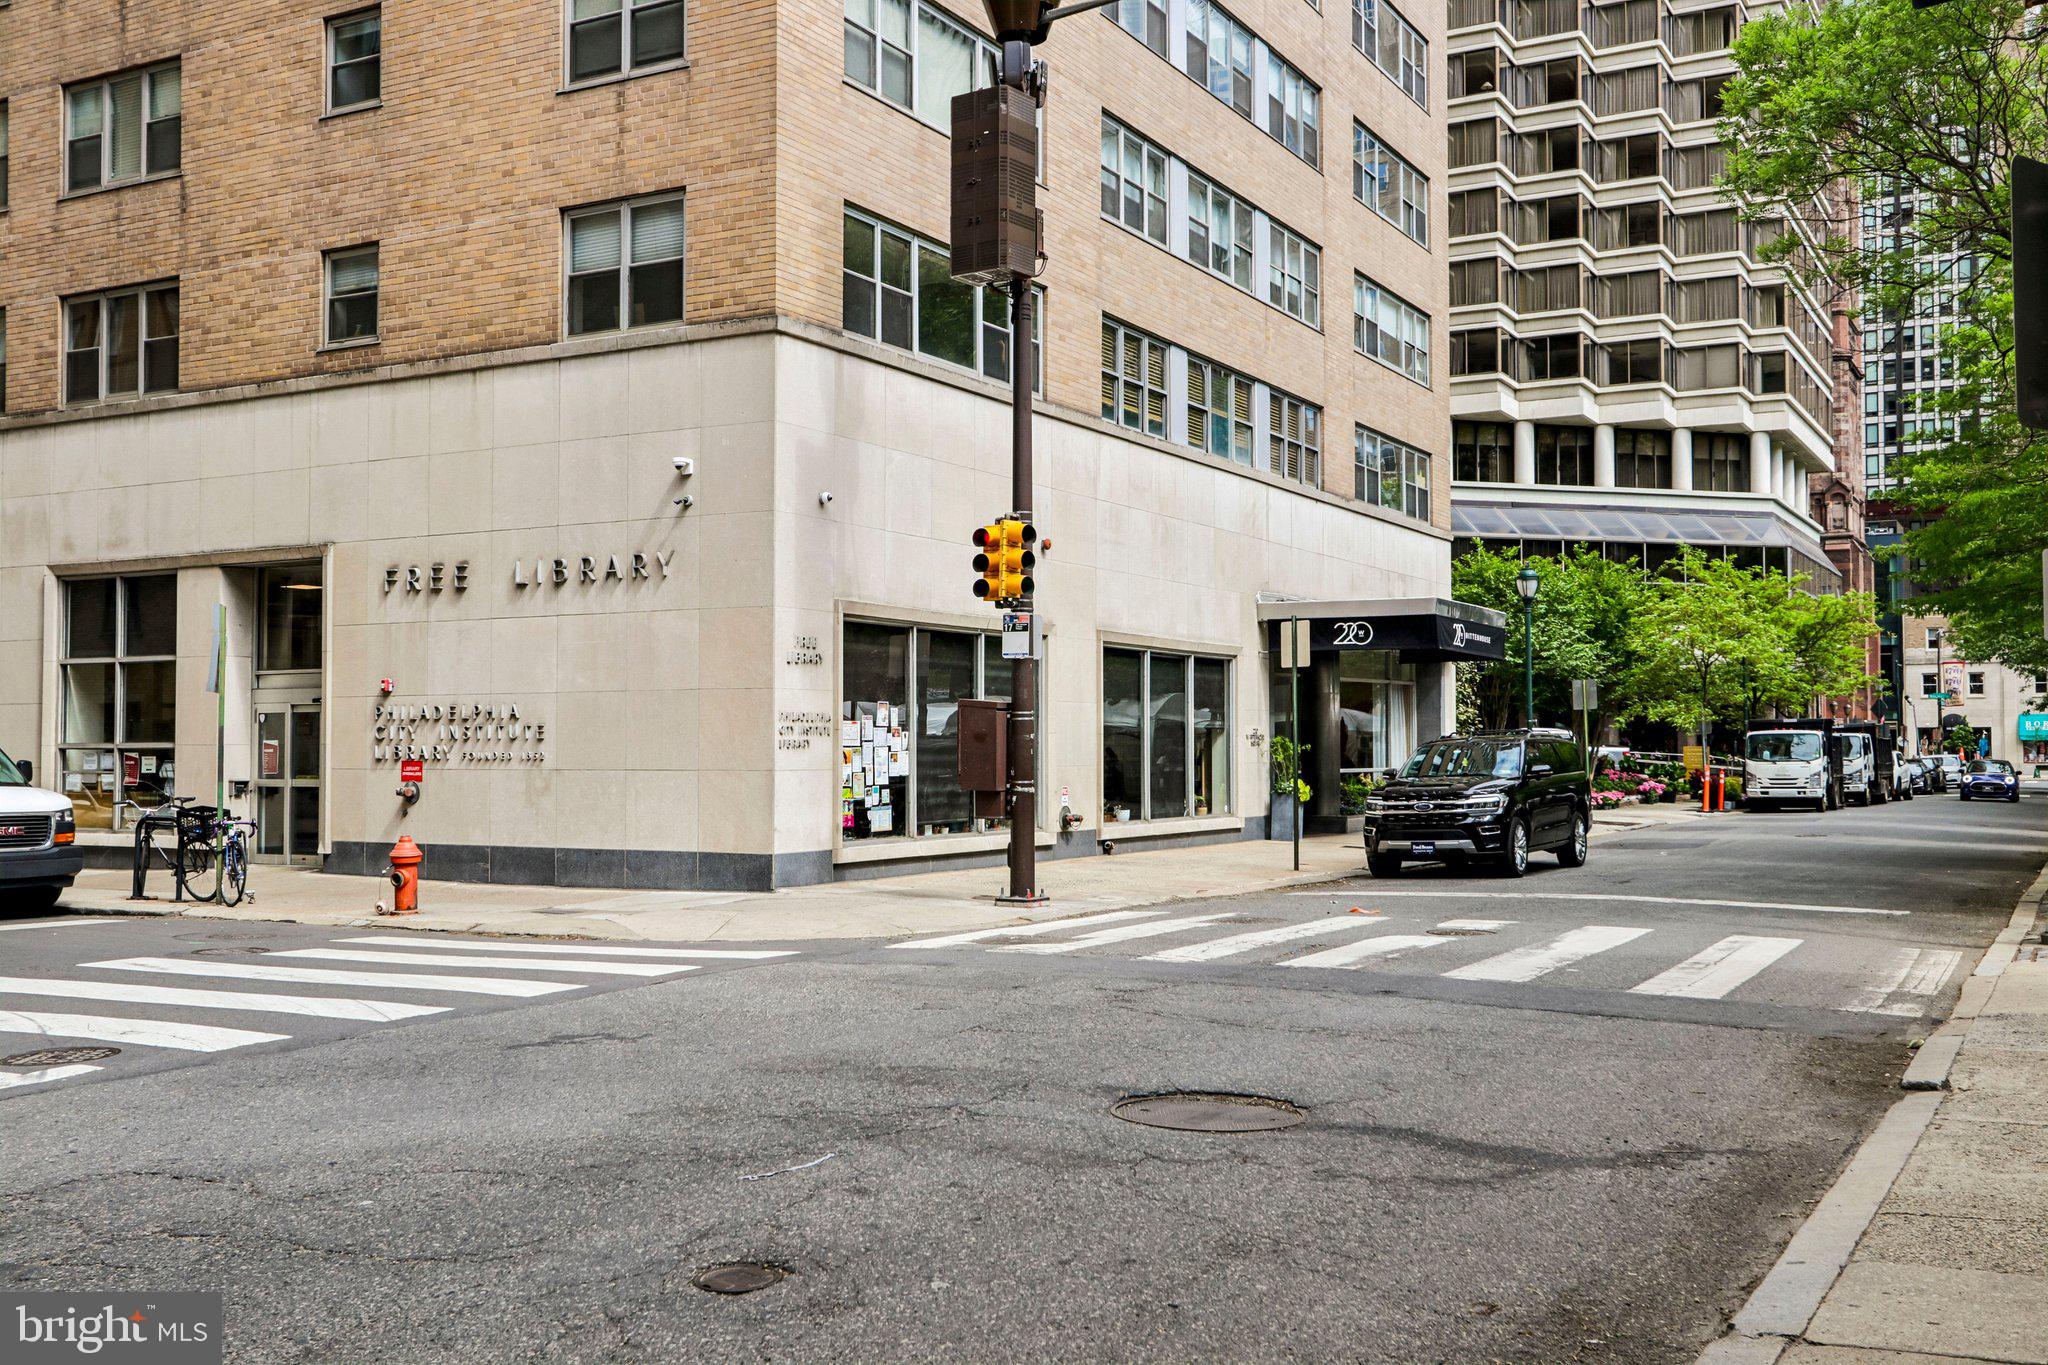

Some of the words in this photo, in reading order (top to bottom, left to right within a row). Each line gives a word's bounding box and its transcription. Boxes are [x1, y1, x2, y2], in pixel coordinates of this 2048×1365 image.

[384, 561, 470, 593] FREE
[514, 550, 675, 586] LIBRARY
[1004, 623, 1013, 632] 17
[374, 703, 520, 723] PHILADELPHIA
[375, 724, 416, 741] CITY
[440, 723, 545, 741] INSTITUTE
[374, 744, 453, 761] LIBRARY
[461, 751, 514, 762] FOUNDED
